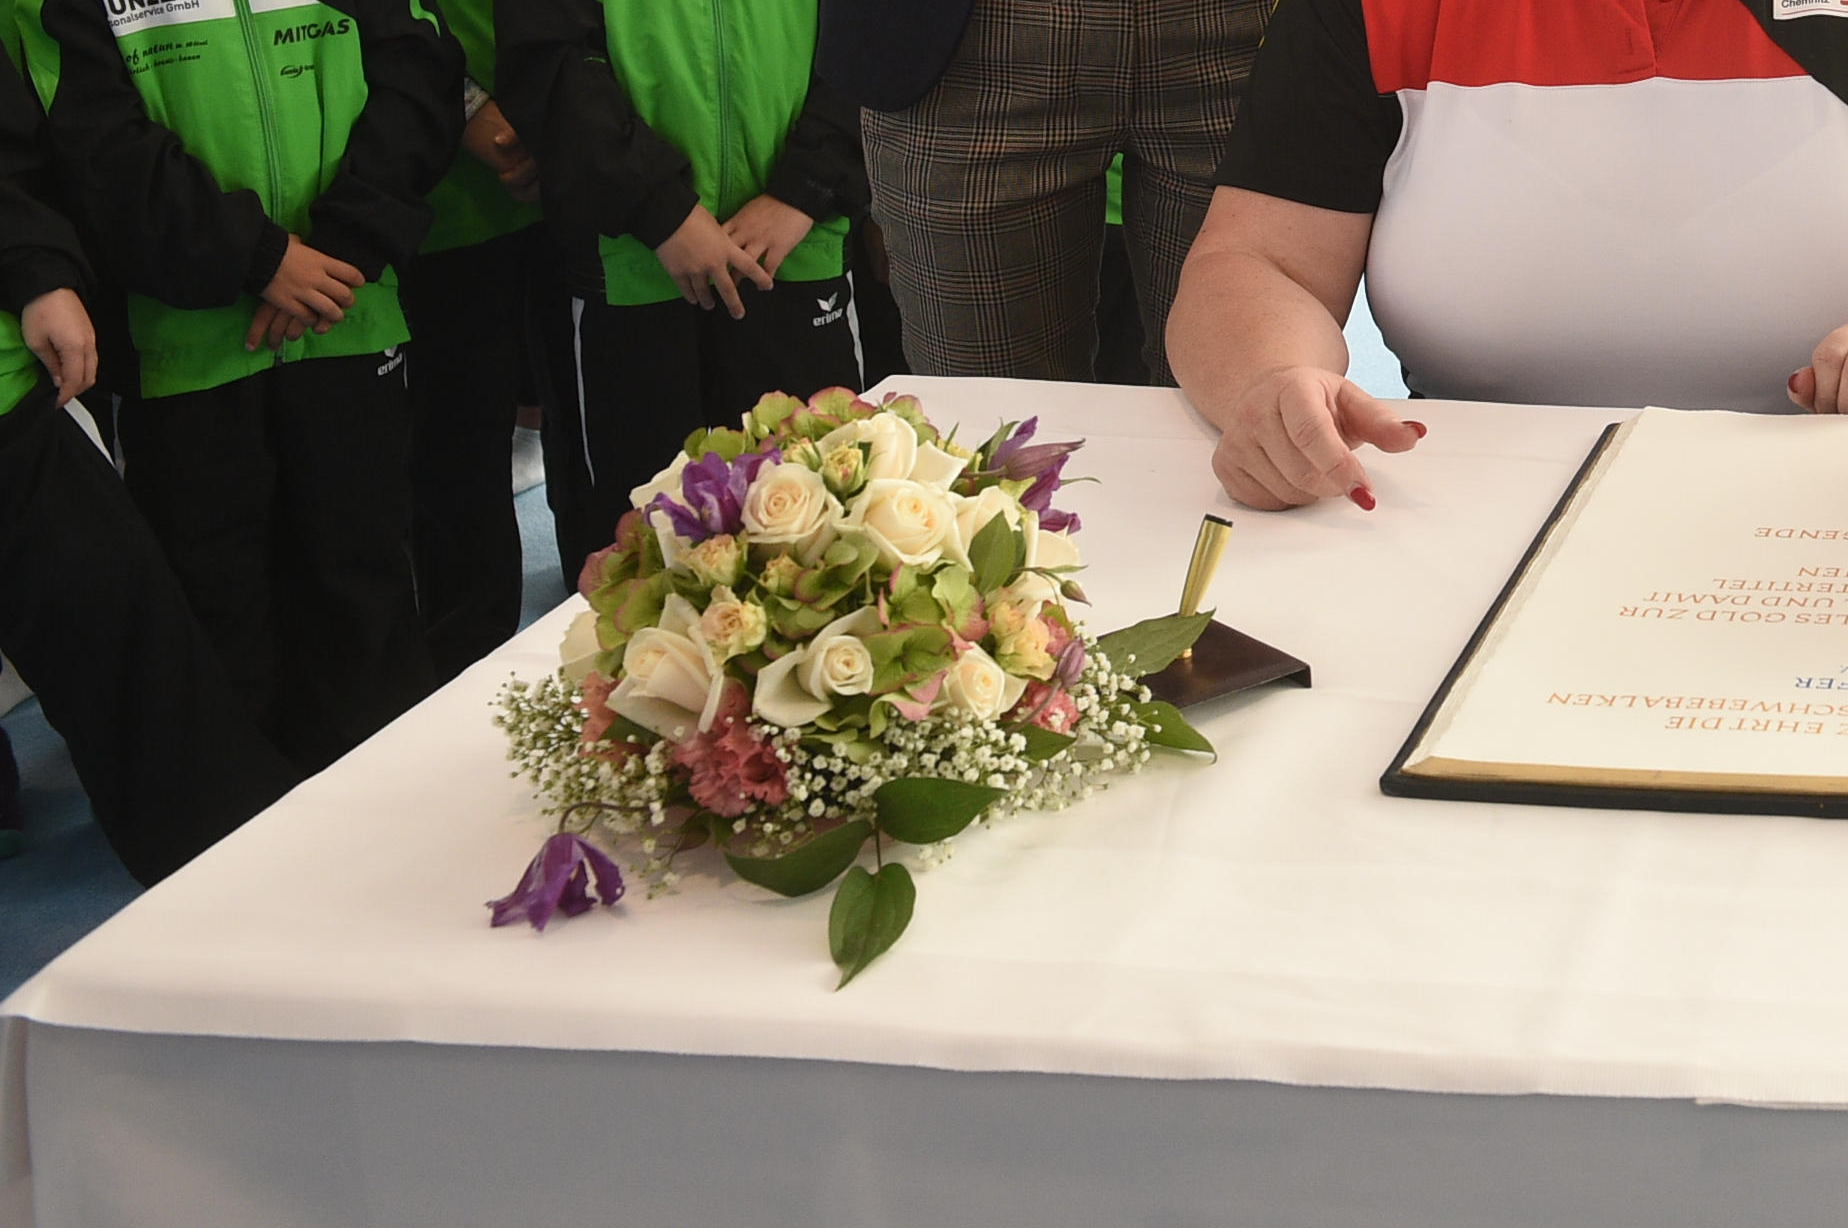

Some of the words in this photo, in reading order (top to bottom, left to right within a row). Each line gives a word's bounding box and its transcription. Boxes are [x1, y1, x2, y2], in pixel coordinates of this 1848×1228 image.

[166, 0, 200, 13] GmbH
[273, 18, 351, 47] MITGAS
[1641, 590, 1752, 606] DAMIT
[1758, 595, 1834, 609] UND
[1618, 605, 1689, 620] ZUR
[1693, 609, 1787, 623] GOLD
[1663, 716, 1723, 730] DIE
[1726, 717, 1824, 735] EHRT
